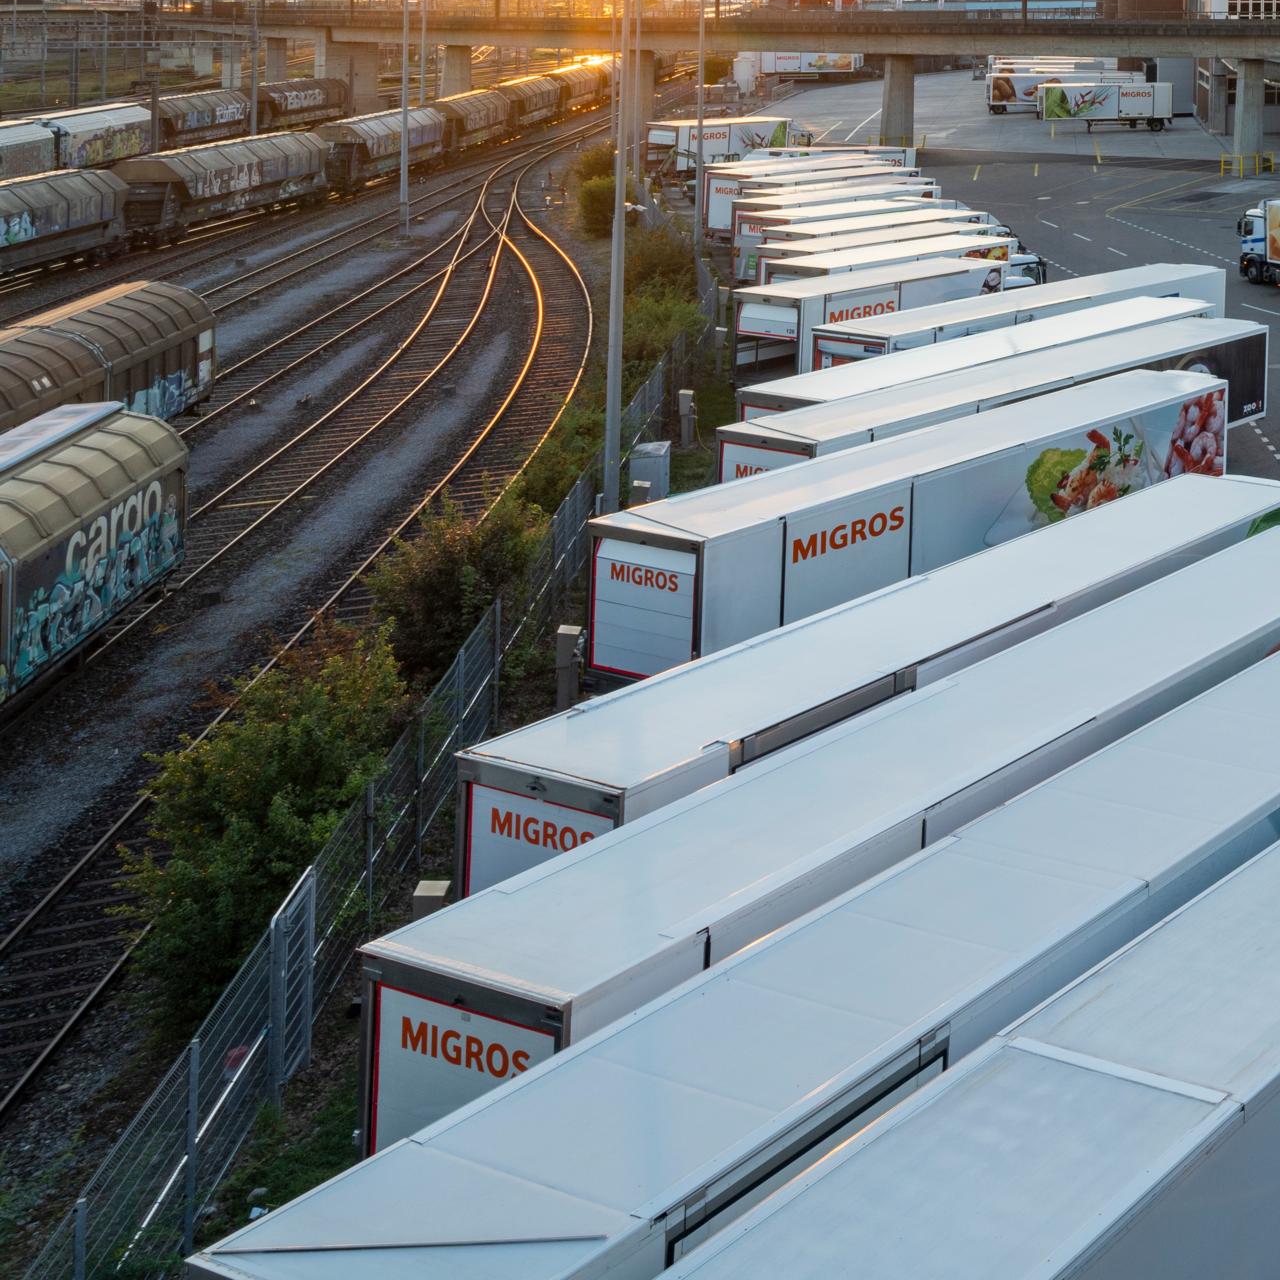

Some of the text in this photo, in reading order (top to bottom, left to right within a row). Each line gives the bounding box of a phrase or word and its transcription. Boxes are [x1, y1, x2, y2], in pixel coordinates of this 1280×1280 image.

[1120, 90, 1152, 98] MIGROS
[691, 131, 728, 141] MGROS
[714, 186, 743, 196] MIGRO
[829, 300, 896, 325] MIGROS
[65, 480, 162, 587] cargo
[793, 505, 905, 564] MIGROS
[610, 562, 679, 593] MIGROS
[401, 1015, 531, 1079] MIGROS
